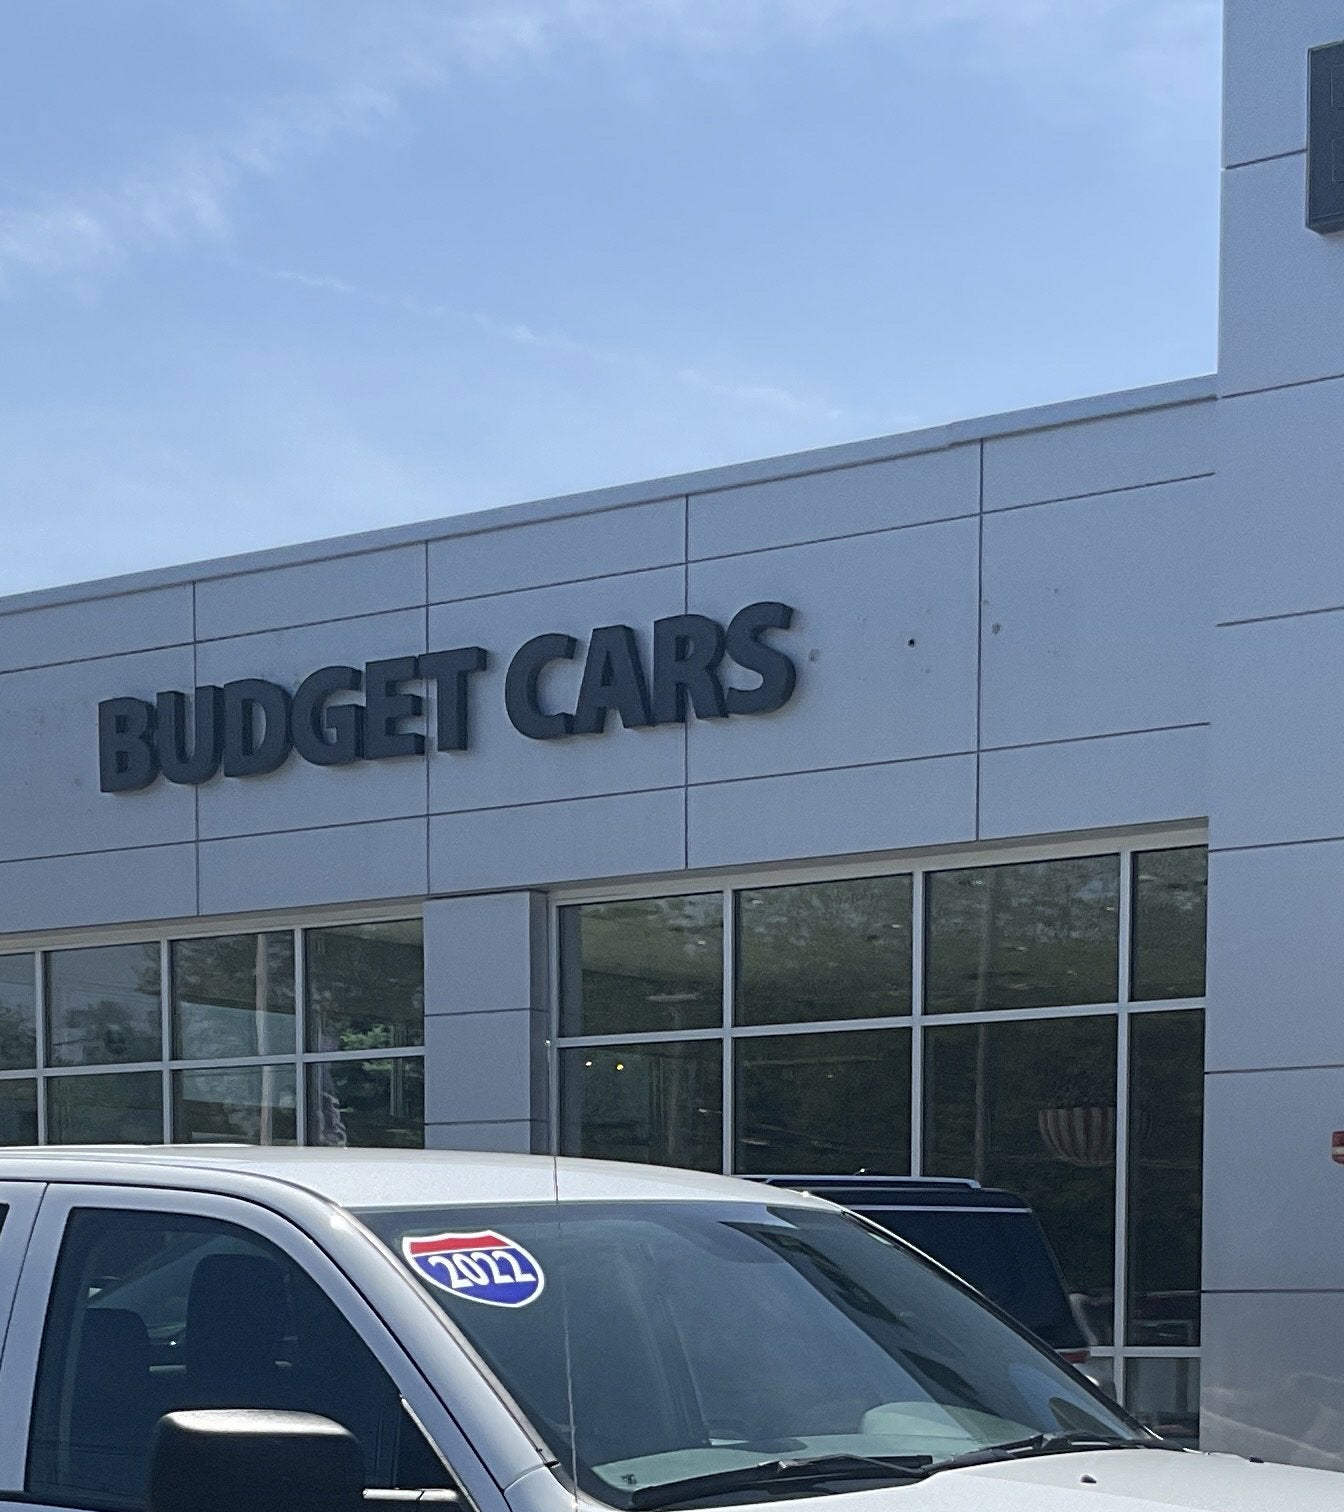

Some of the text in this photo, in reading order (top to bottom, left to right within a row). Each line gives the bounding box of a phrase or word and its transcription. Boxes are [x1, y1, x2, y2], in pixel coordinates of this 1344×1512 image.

[98, 601, 797, 793] BUDGET CARS
[427, 1250, 537, 1289] 2022
